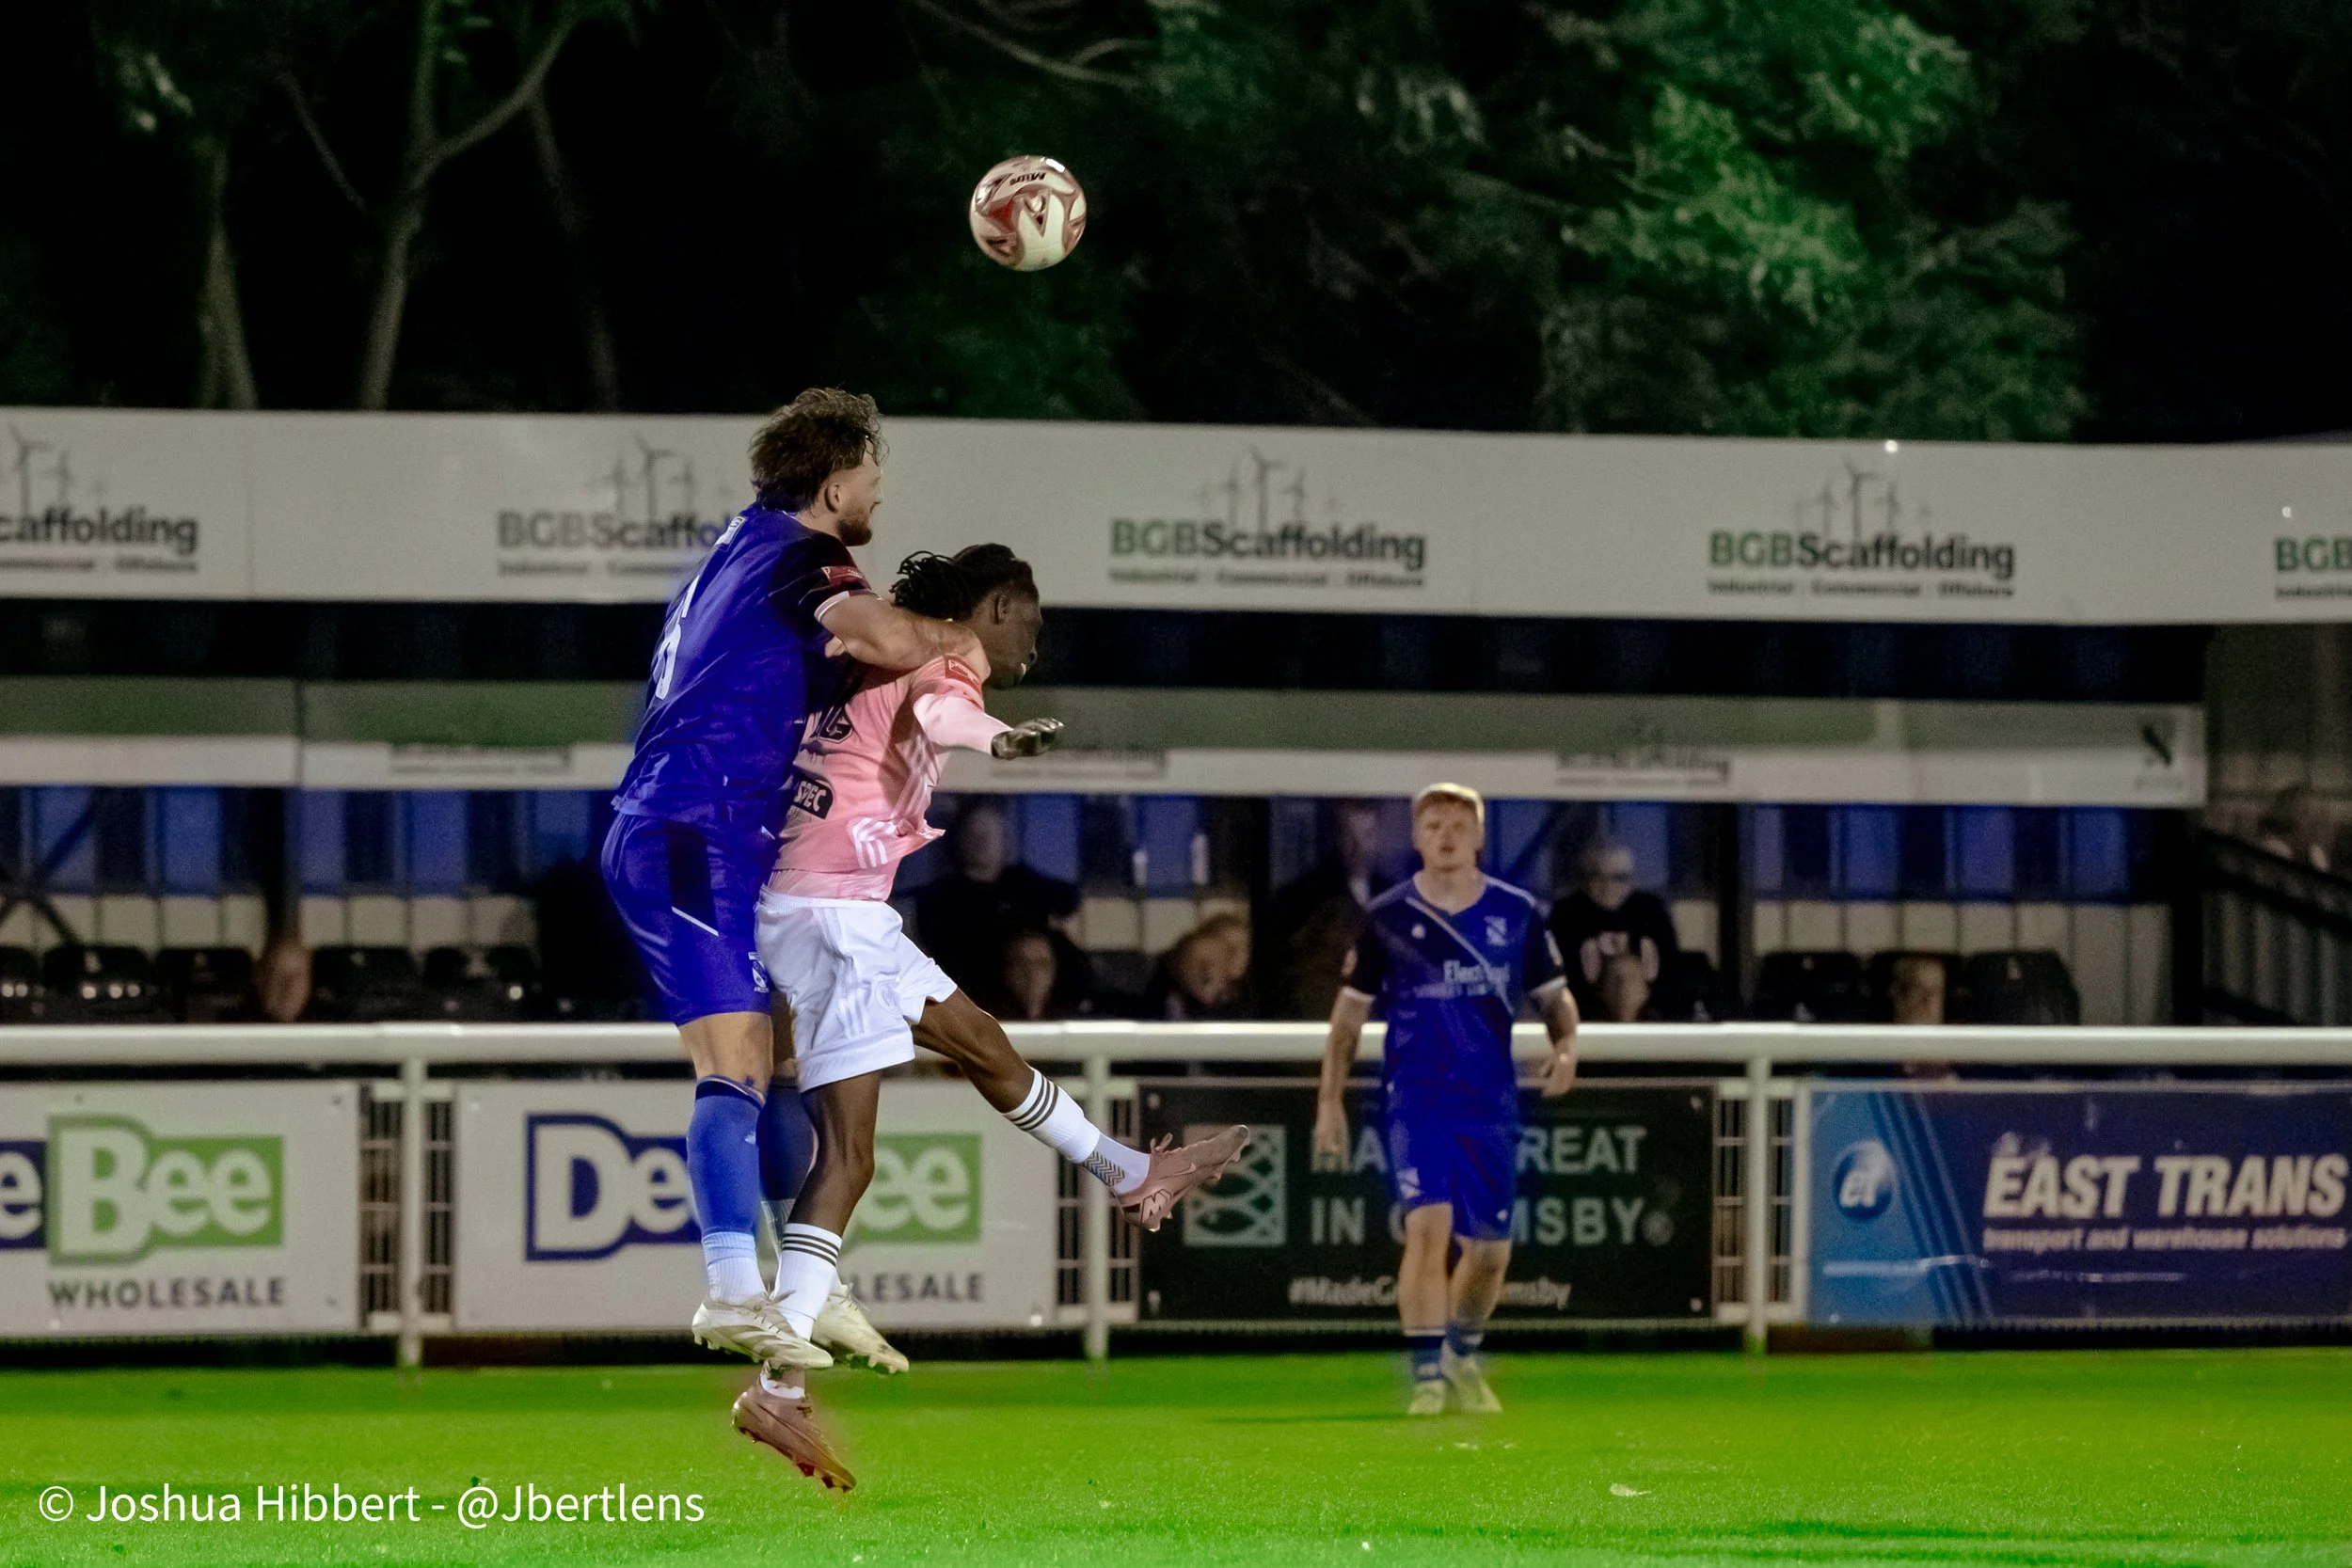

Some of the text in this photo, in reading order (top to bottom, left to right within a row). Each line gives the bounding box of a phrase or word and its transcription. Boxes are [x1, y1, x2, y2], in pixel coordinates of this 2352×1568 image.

[1111, 520, 1426, 572] BGBScaffolding
[1708, 532, 2015, 579] BGBScaffolding
[1516, 1127, 1647, 1174] REAT
[51, 1117, 278, 1262] Bee
[1983, 1153, 2350, 1219] EAST TRANS
[1311, 1197, 1365, 1245] IN
[48, 1277, 285, 1308] WHOLESALE
